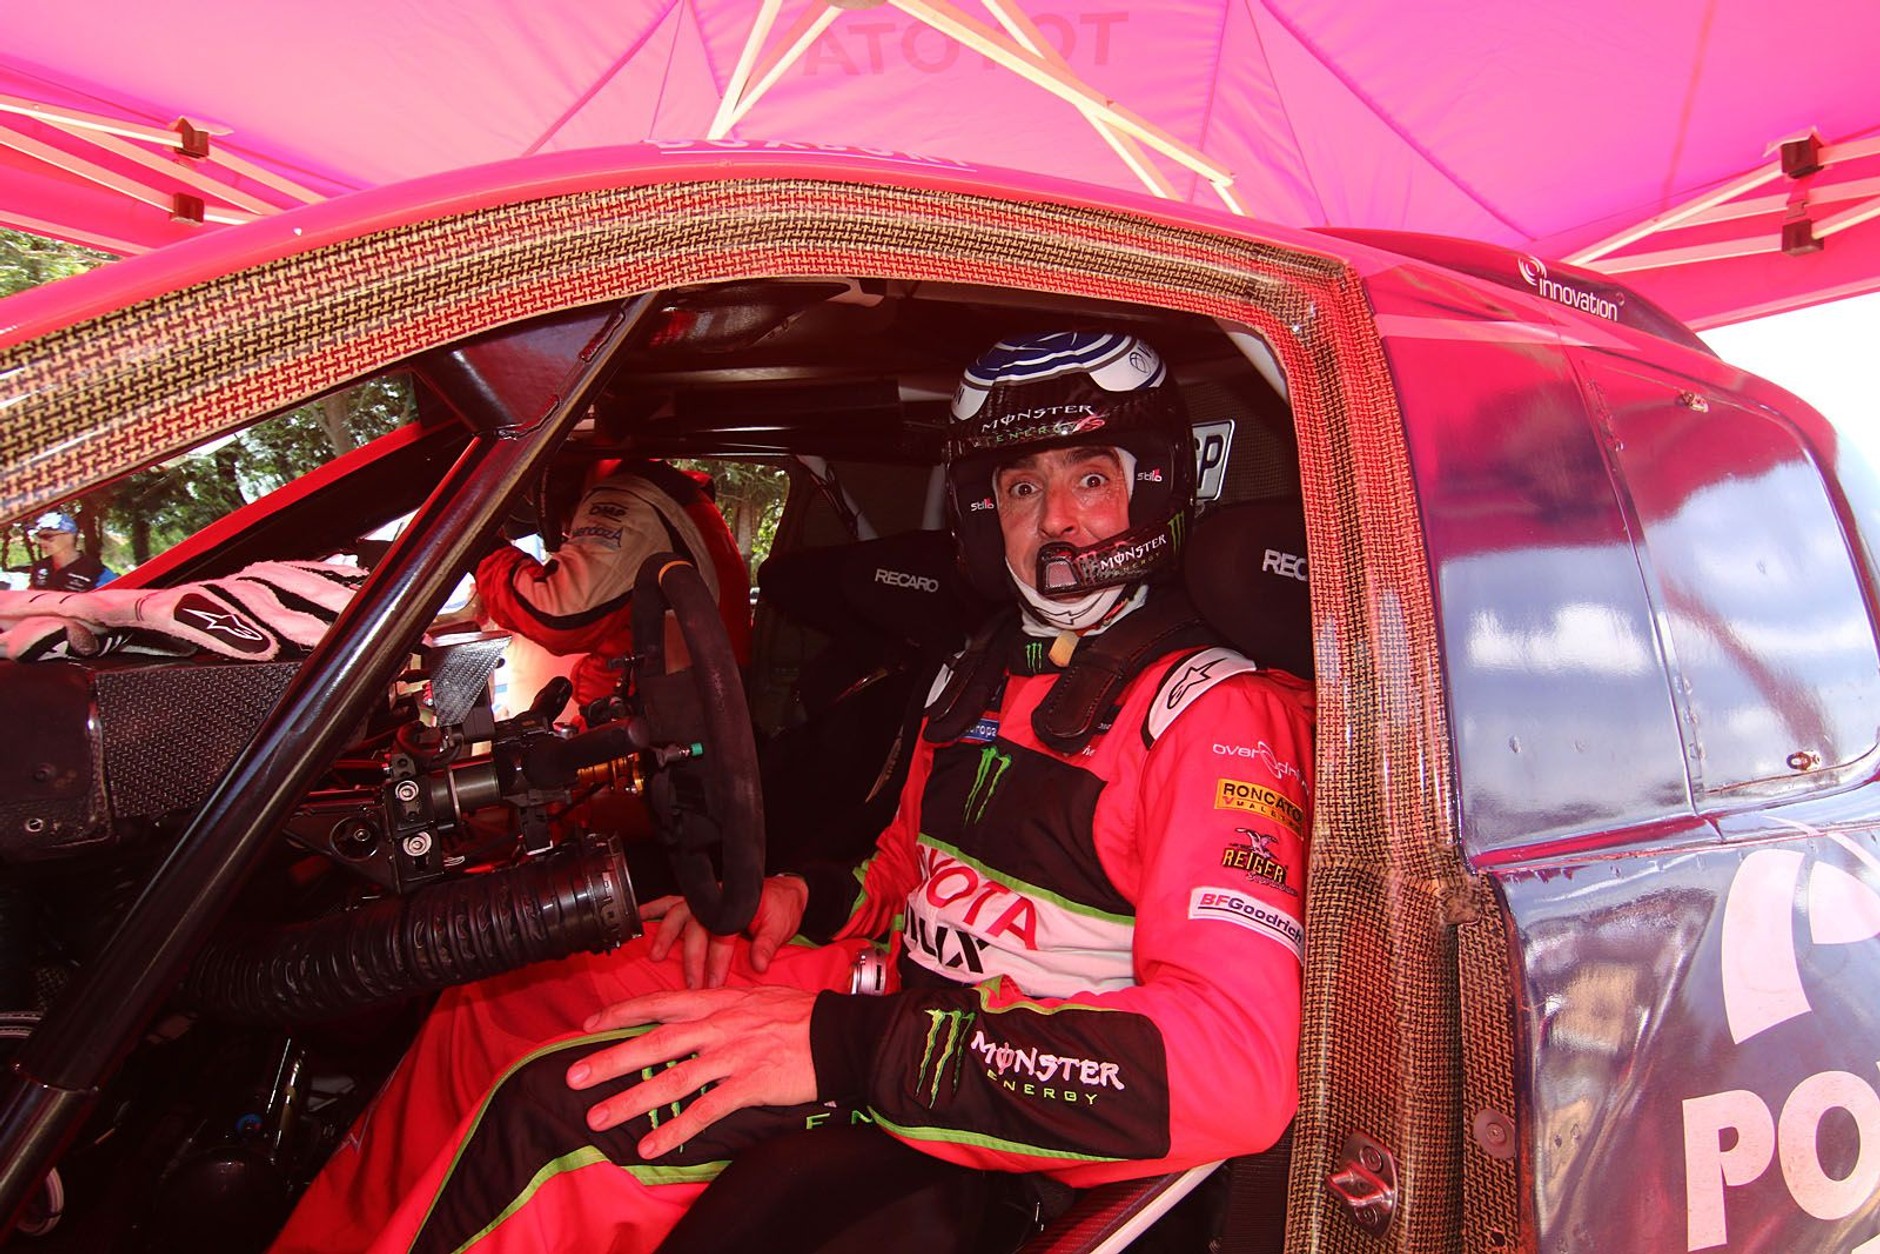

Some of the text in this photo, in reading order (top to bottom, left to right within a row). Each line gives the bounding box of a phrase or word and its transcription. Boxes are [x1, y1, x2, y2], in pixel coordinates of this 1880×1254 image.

[1538, 277, 1618, 322] innovation
[874, 568, 939, 593] RECARO
[1223, 783, 1303, 821] RONCATO
[1221, 848, 1287, 883] REIGER
[917, 845, 1038, 951] YOTA
[1200, 893, 1302, 944] BFGoodrich
[986, 1069, 1098, 1105] ENERGY
